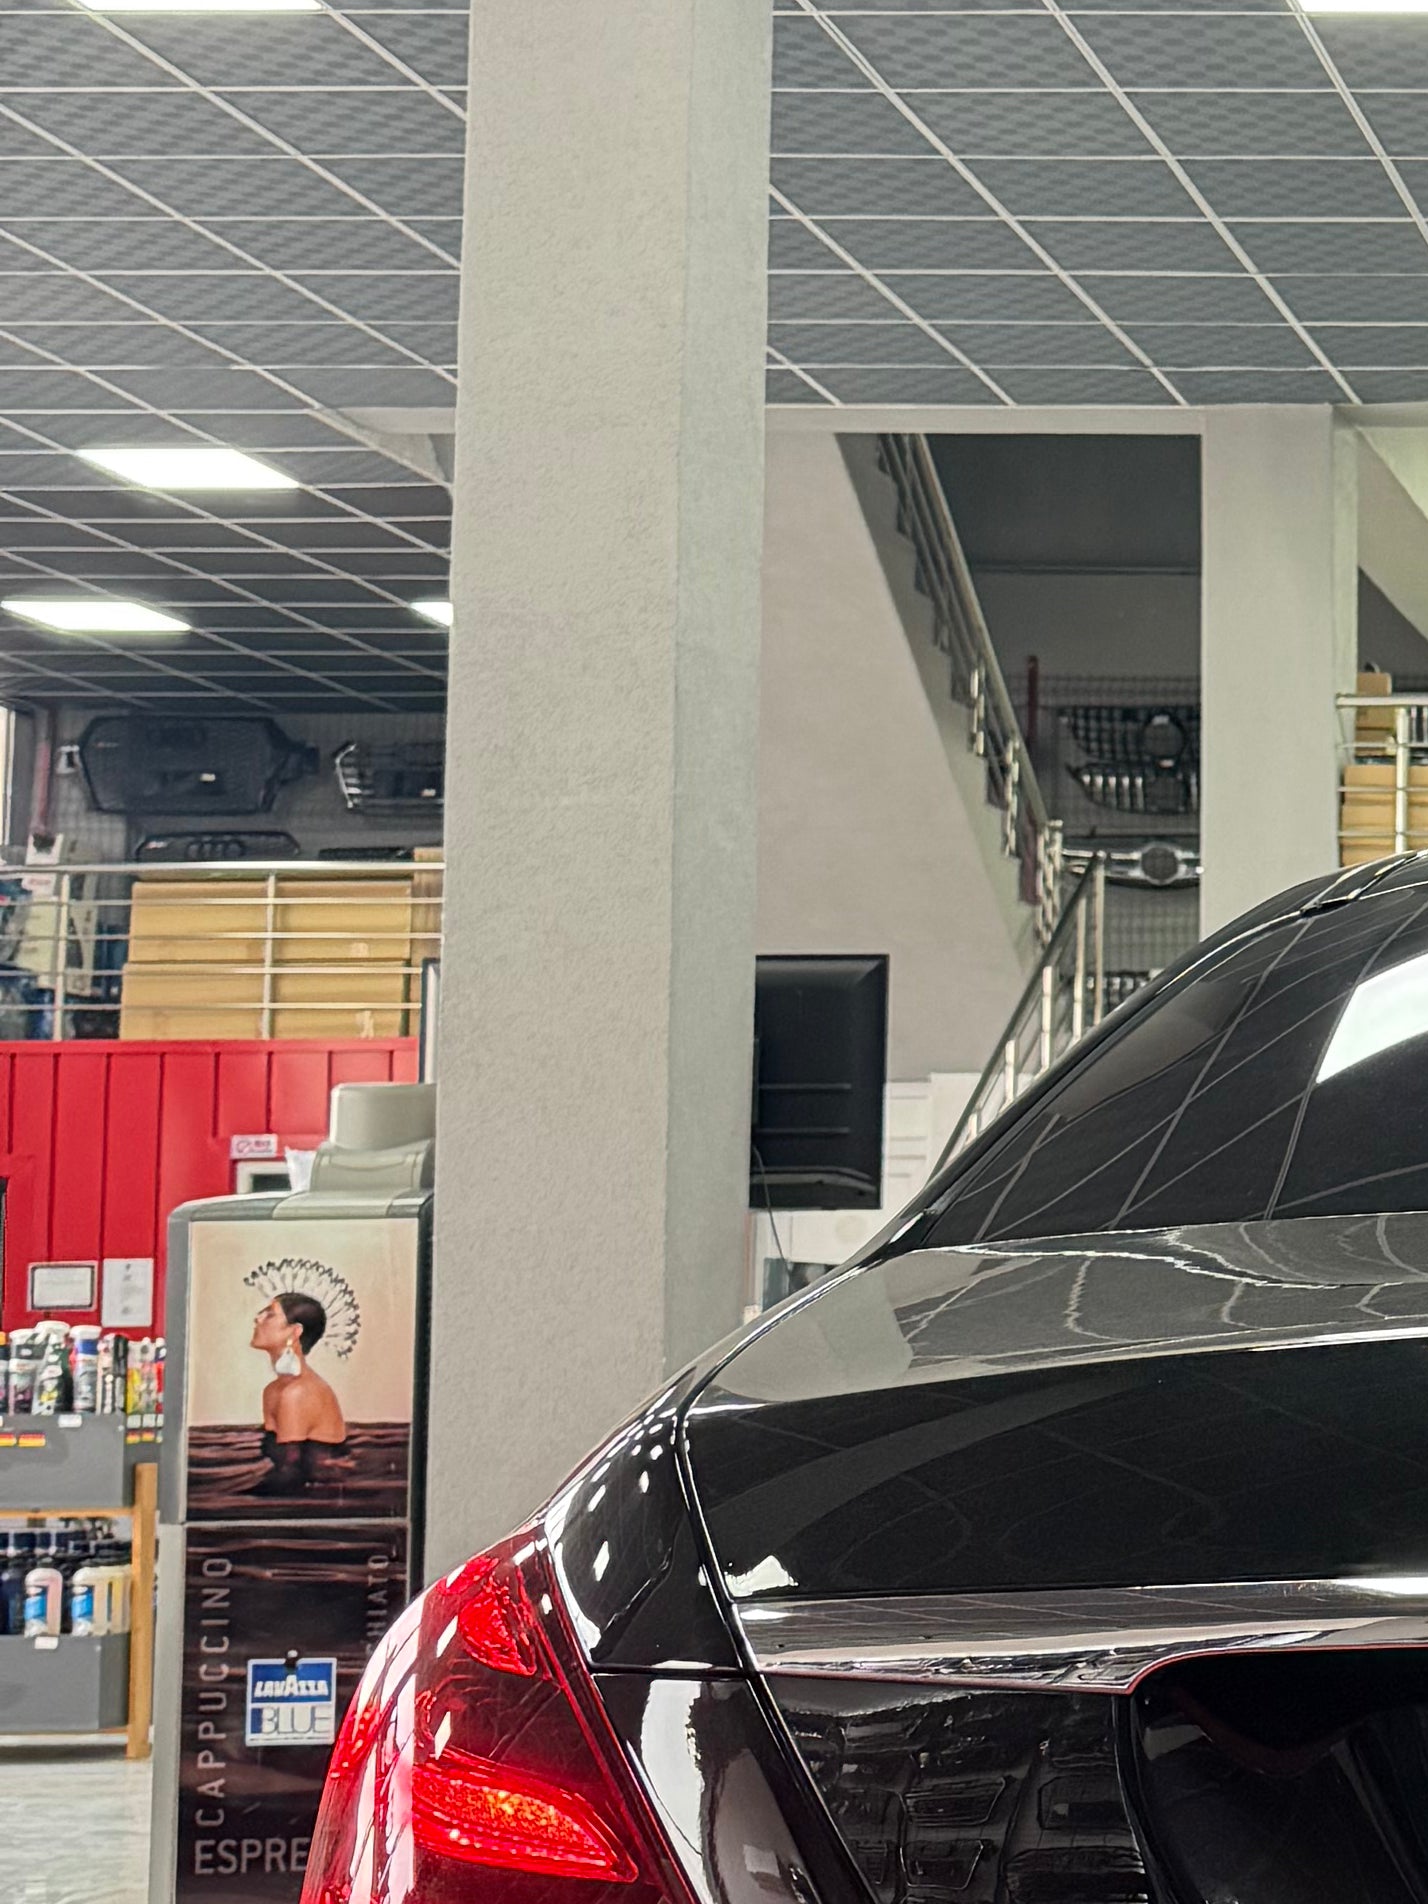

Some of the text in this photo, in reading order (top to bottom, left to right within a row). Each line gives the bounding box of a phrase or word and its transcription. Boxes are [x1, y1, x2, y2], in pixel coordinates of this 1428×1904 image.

[195, 1557, 233, 1828] CAPPUCCINO
[253, 1674, 329, 1698] LAVAZZA
[252, 1706, 332, 1735] BLUE
